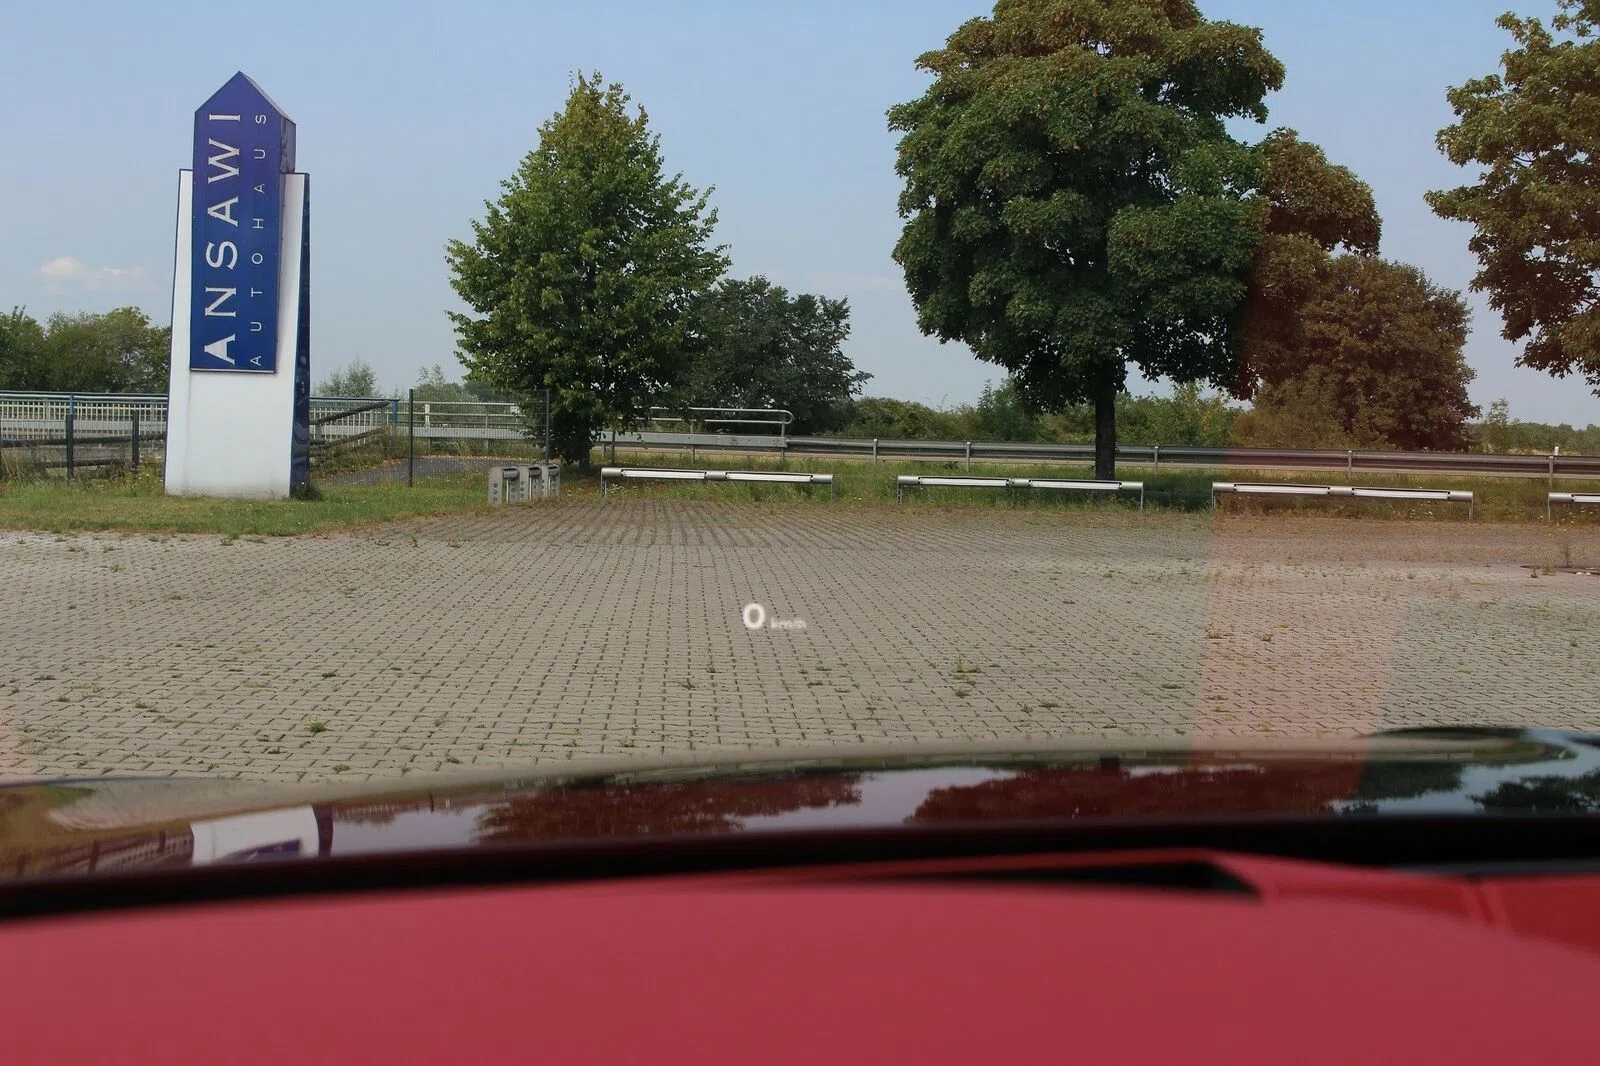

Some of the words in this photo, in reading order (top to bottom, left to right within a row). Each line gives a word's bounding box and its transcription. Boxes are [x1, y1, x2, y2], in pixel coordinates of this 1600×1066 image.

[204, 113, 241, 365] ANSAWI
[250, 113, 267, 367] AUTOHAUS
[743, 603, 765, 629] 0
